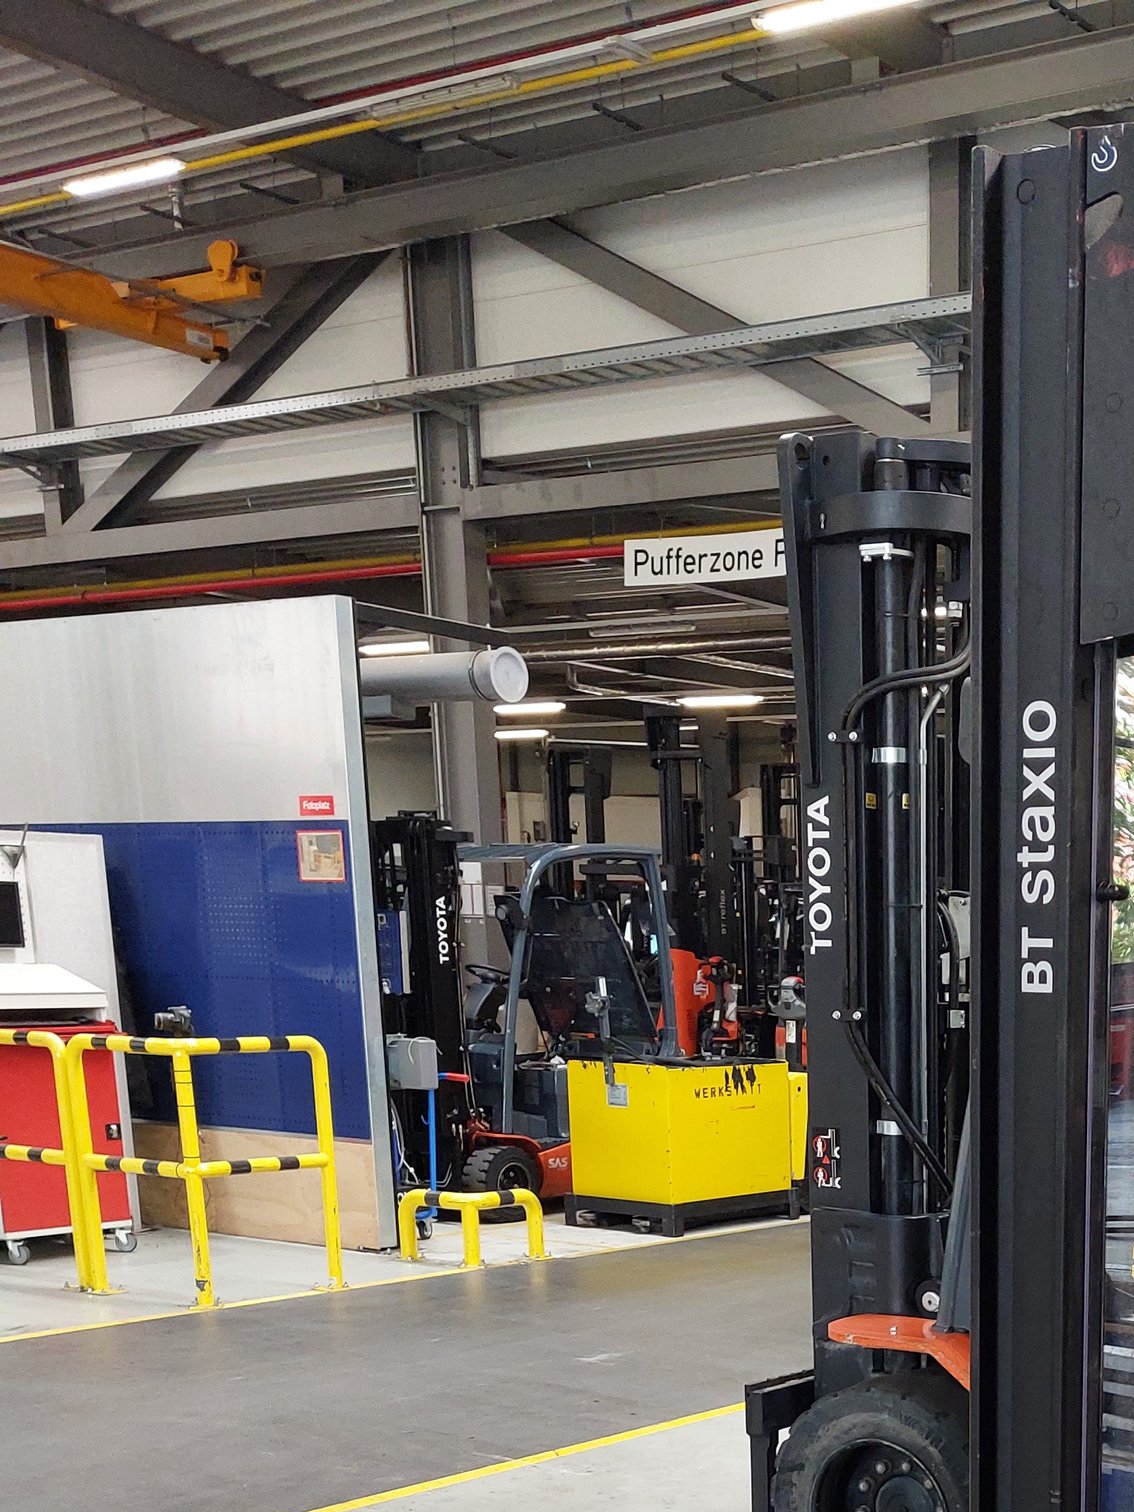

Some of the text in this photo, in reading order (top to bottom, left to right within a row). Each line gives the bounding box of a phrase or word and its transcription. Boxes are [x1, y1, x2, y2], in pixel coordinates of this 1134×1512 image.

[634, 547, 763, 577] Pufferzone
[807, 795, 832, 955] TOYOTA
[1017, 700, 1057, 993] BT staxio
[436, 896, 450, 964] TOYOTA
[548, 1157, 568, 1168] SAS
